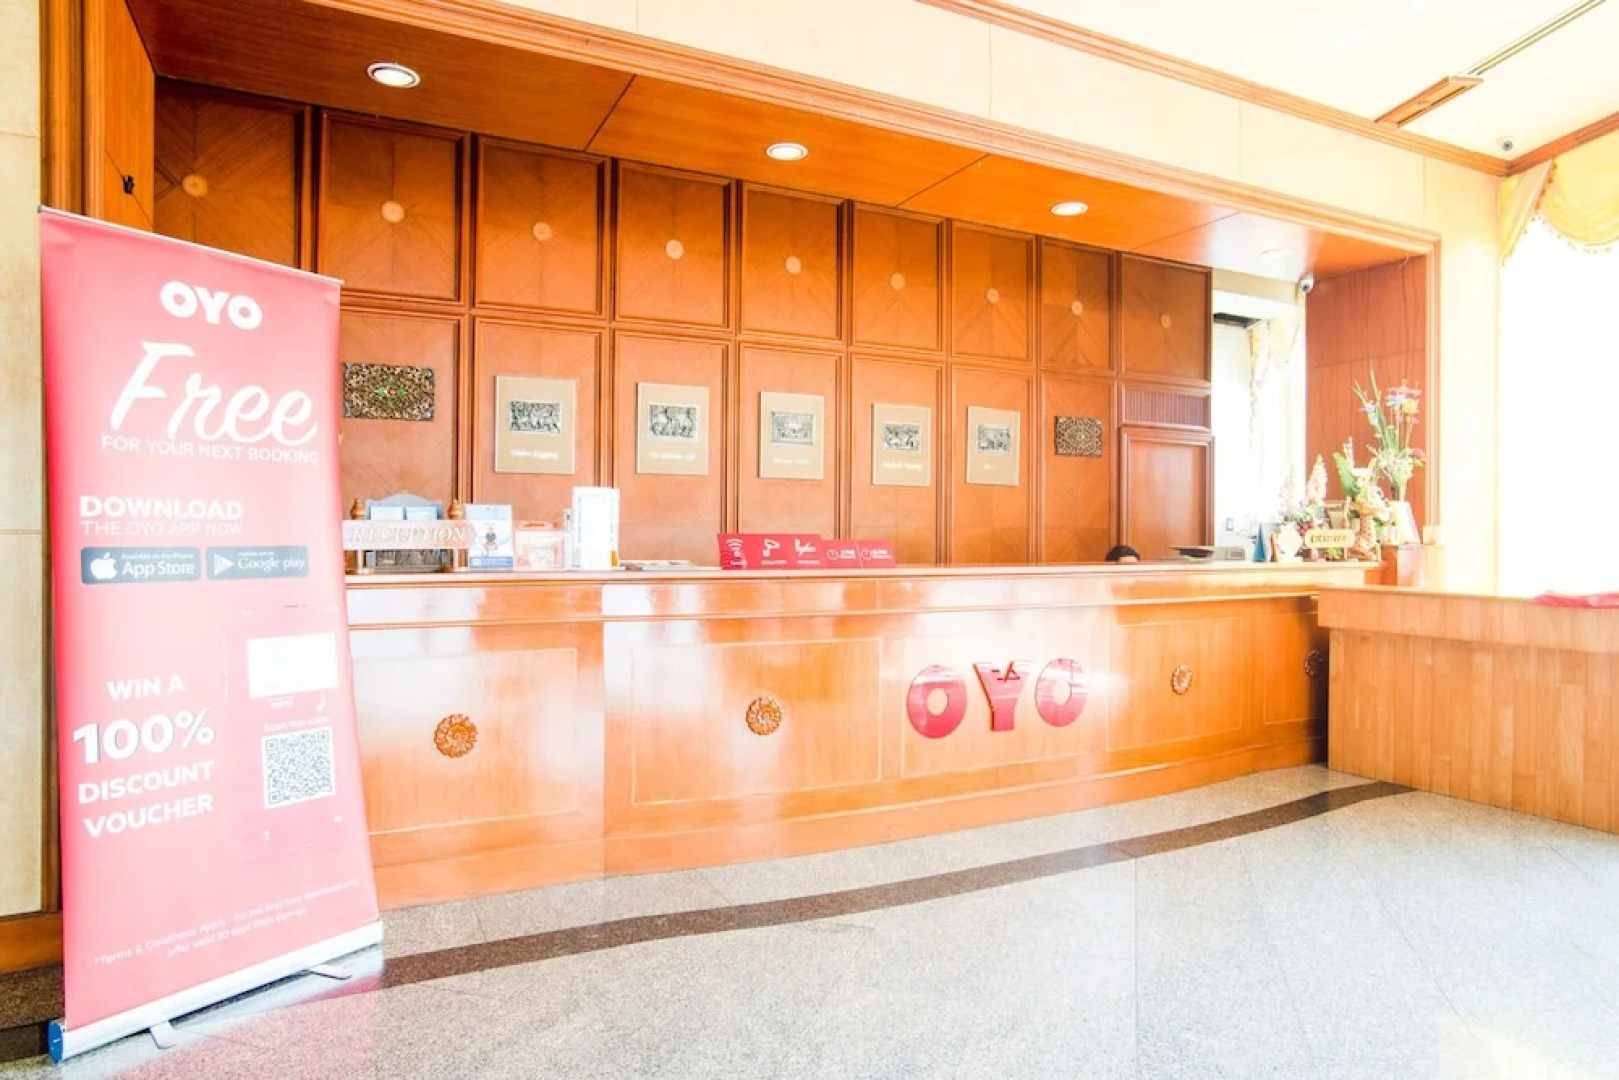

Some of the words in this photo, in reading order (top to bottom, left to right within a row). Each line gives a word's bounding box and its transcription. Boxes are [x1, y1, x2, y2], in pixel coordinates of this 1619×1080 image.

[160, 281, 262, 330] OYO
[110, 341, 318, 446] Free
[101, 435, 140, 452] FOR
[147, 440, 194, 456] YOUR
[199, 444, 243, 461] NEXT
[248, 447, 319, 465] BOOKING
[79, 495, 244, 521] DOWNLOAD
[80, 521, 121, 536] THE
[168, 522, 201, 536] APP
[206, 522, 243, 536] NOW
[122, 561, 155, 579] App
[158, 560, 195, 575] Store
[238, 557, 280, 572] Google
[283, 556, 305, 571] play
[106, 677, 161, 701] WIN
[168, 674, 186, 693] A
[906, 658, 1089, 739] OYO
[72, 708, 215, 764] 100%
[78, 760, 215, 804] DISCOUNT
[84, 794, 214, 838] VOUCHER
